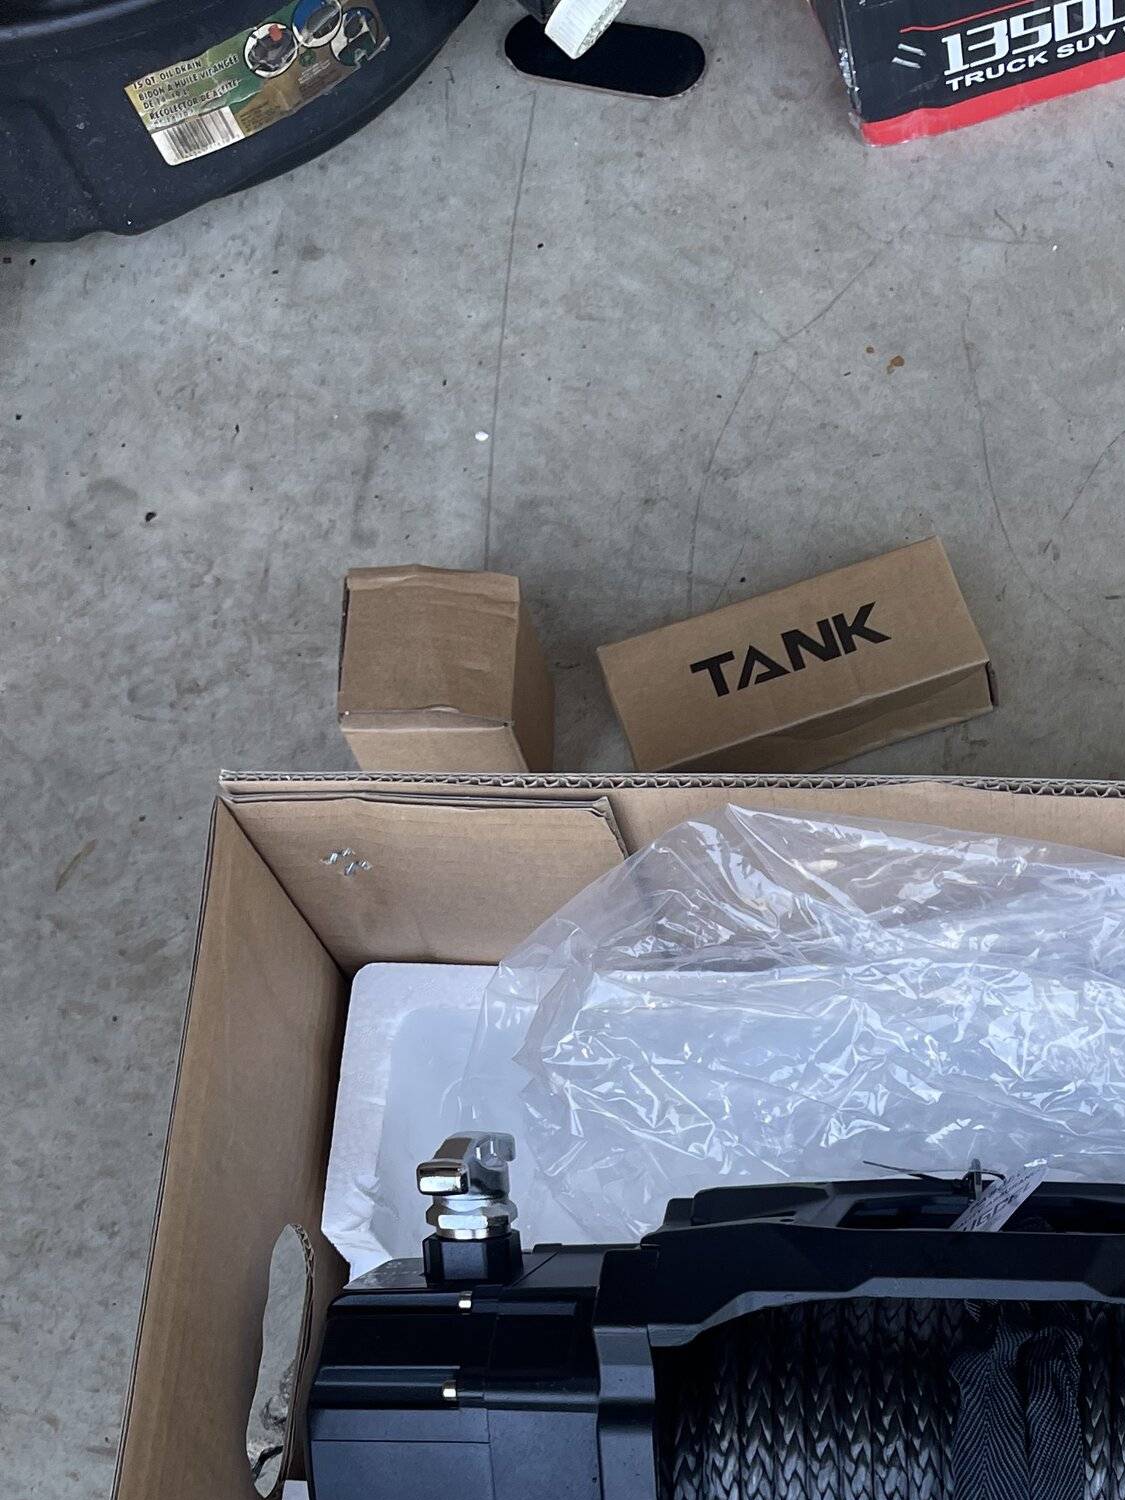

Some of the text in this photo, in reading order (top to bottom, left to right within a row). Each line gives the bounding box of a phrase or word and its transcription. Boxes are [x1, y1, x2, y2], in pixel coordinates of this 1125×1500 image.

[160, 70, 173, 81] OIL
[175, 60, 202, 75] DRAIN
[946, 51, 1049, 91] TRUCK
[1056, 30, 1116, 58] SUV
[138, 87, 165, 101] BIDON
[174, 73, 198, 89] HUILE
[149, 97, 199, 120] RECOLECTOR
[690, 601, 892, 697] TANK
